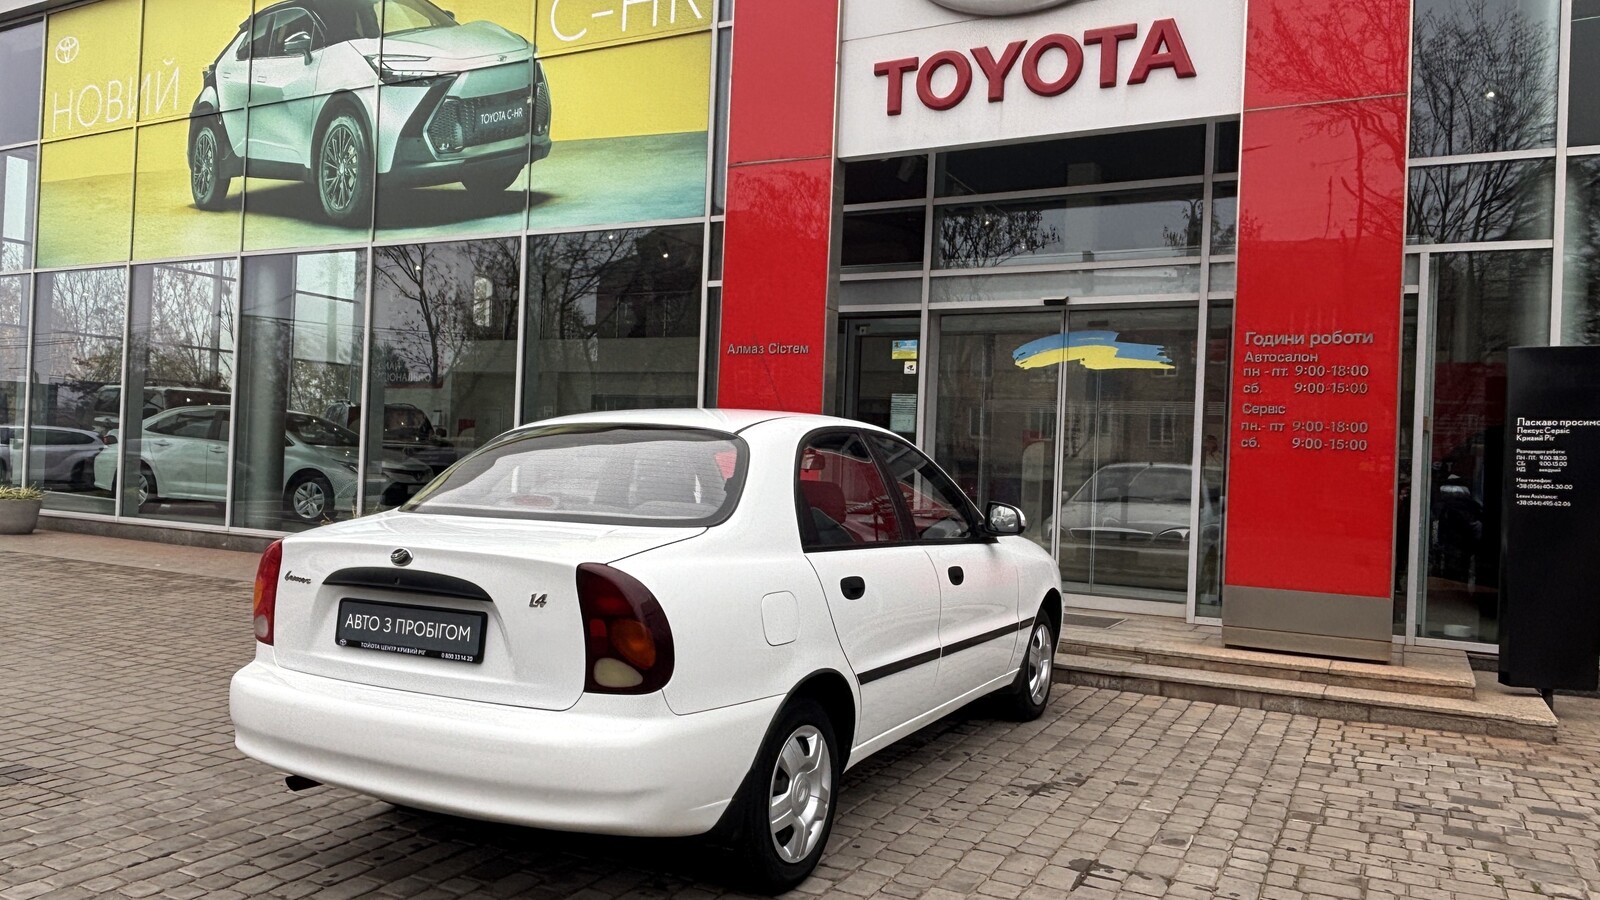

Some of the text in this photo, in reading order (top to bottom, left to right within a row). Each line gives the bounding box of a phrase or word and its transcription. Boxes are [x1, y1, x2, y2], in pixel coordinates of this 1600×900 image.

[873, 17, 1197, 116] TOYOTA
[52, 57, 180, 133] НОВИЙ
[480, 107, 523, 124] TOYOTA C-HR
[1244, 330, 1374, 348] Години роботи
[727, 342, 810, 354] Алмаз Сістем
[1244, 351, 1318, 363] Автосалон
[1242, 402, 1286, 417] Сервіс
[1292, 437, 1368, 451] 9:00-15:00
[344, 613, 472, 642] АВТО З ПРОБІГОМ
[361, 642, 380, 651] ТОЙОТА
[381, 645, 397, 653] ЦЕНТР
[397, 646, 418, 655] КРИВИЙ
[445, 652, 455, 660] 800
